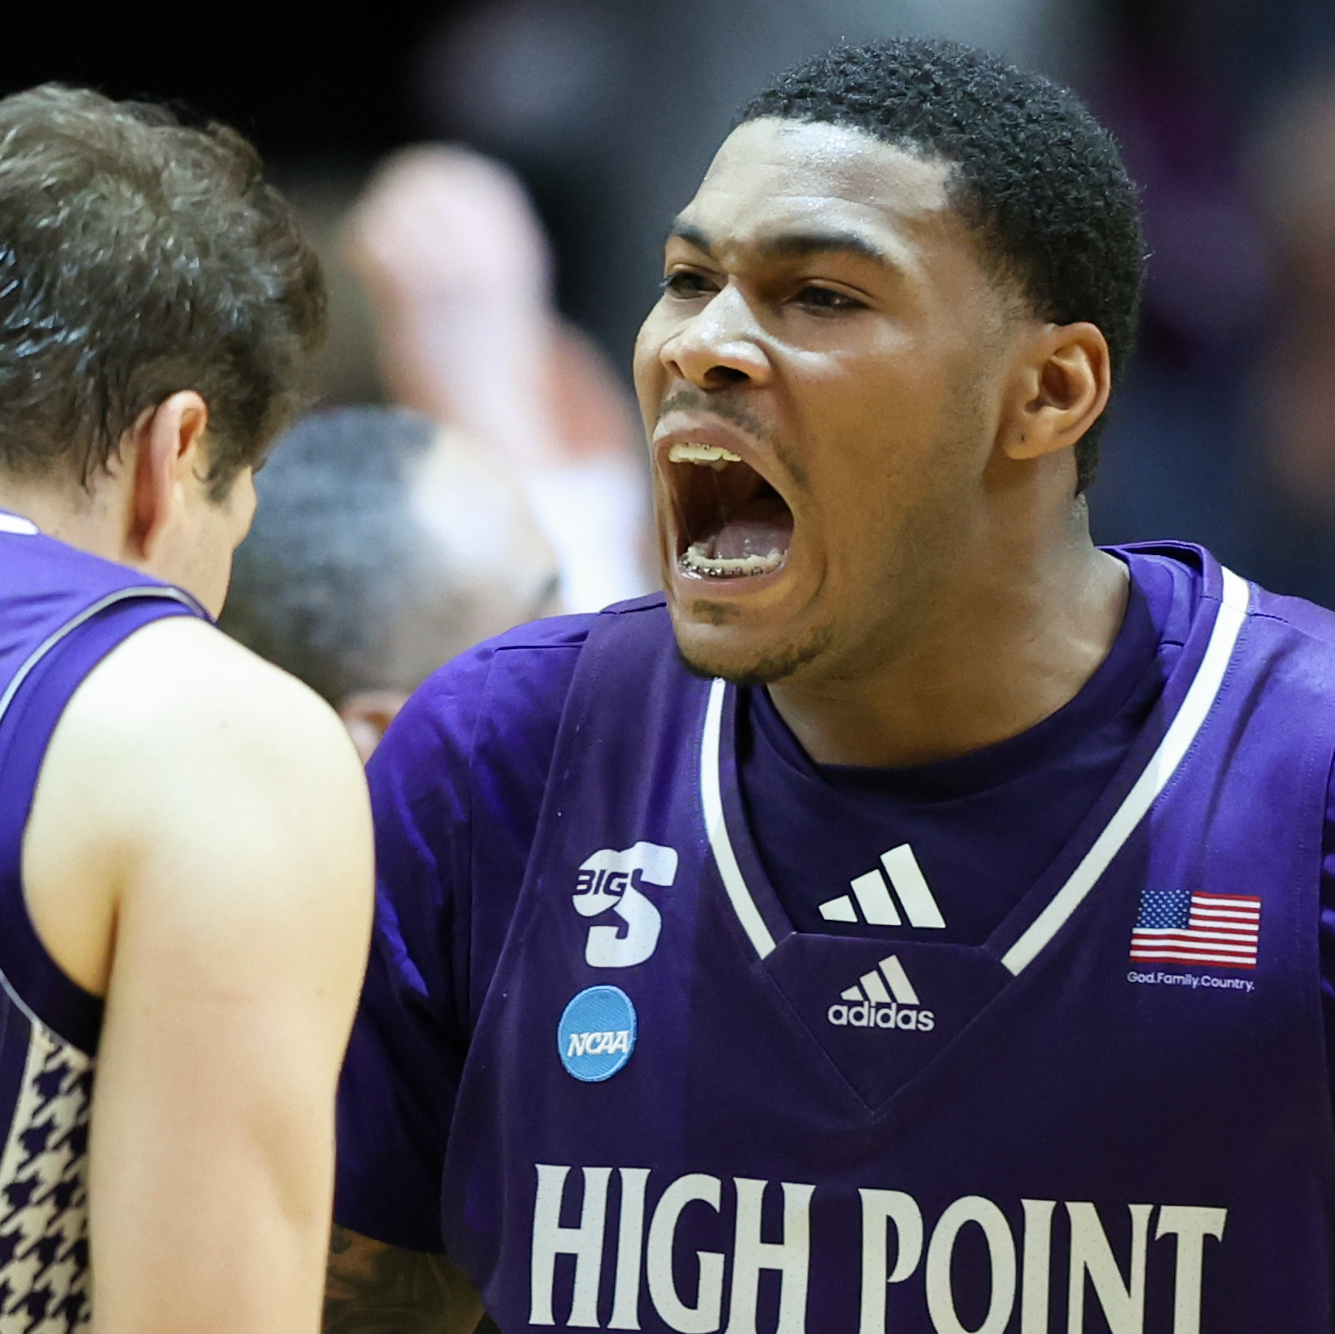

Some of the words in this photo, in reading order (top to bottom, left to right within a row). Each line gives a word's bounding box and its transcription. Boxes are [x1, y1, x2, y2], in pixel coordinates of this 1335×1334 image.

[575, 868, 628, 897] BIG
[827, 1001, 935, 1031] adidas
[567, 1030, 630, 1057] NCAA
